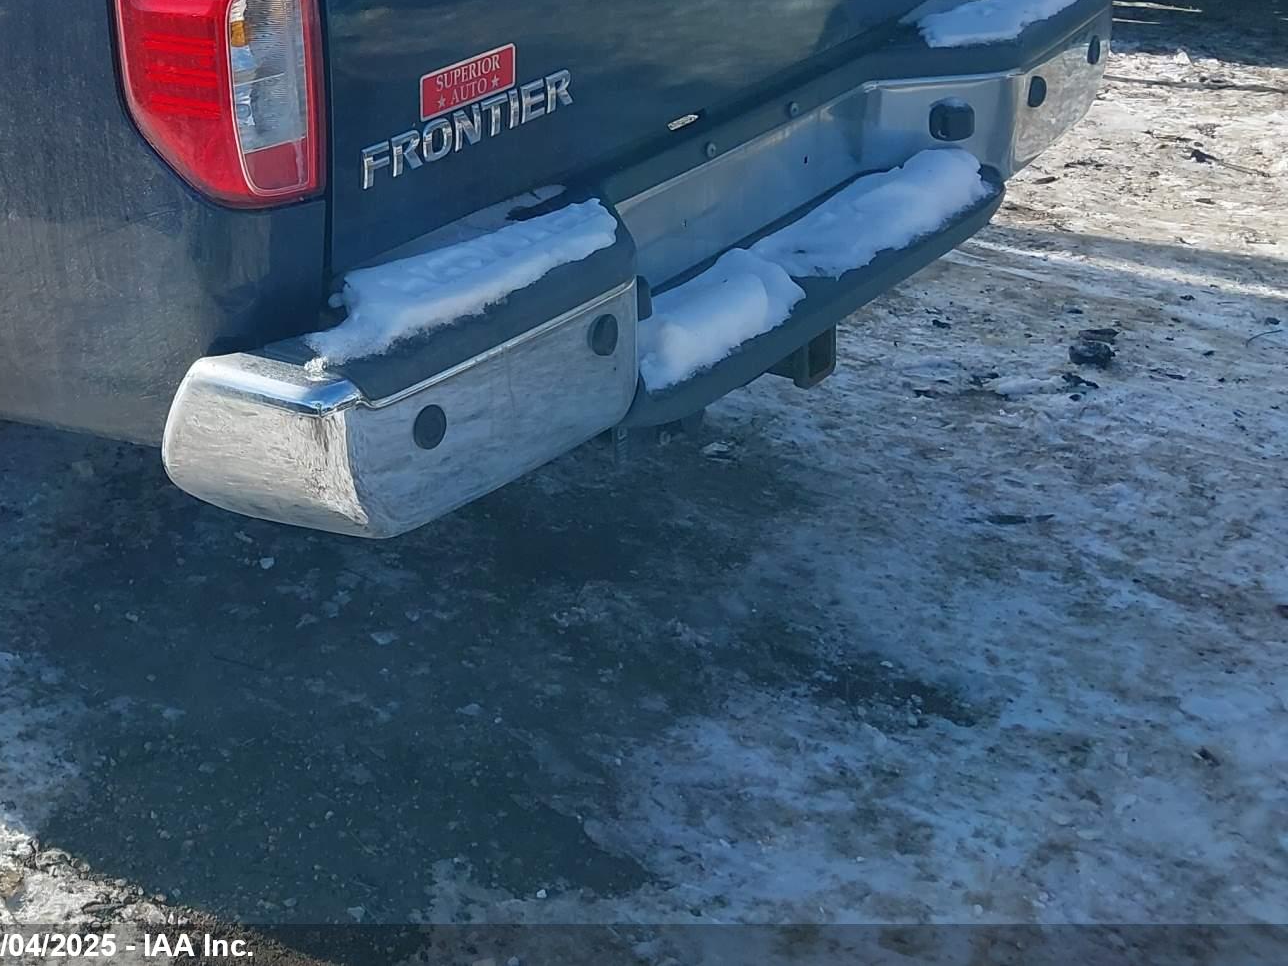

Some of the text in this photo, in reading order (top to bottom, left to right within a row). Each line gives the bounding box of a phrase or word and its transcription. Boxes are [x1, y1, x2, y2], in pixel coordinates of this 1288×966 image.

[435, 54, 501, 92] SUPERIOR
[450, 77, 488, 105] AUTO
[362, 69, 573, 190] FRONTIER
